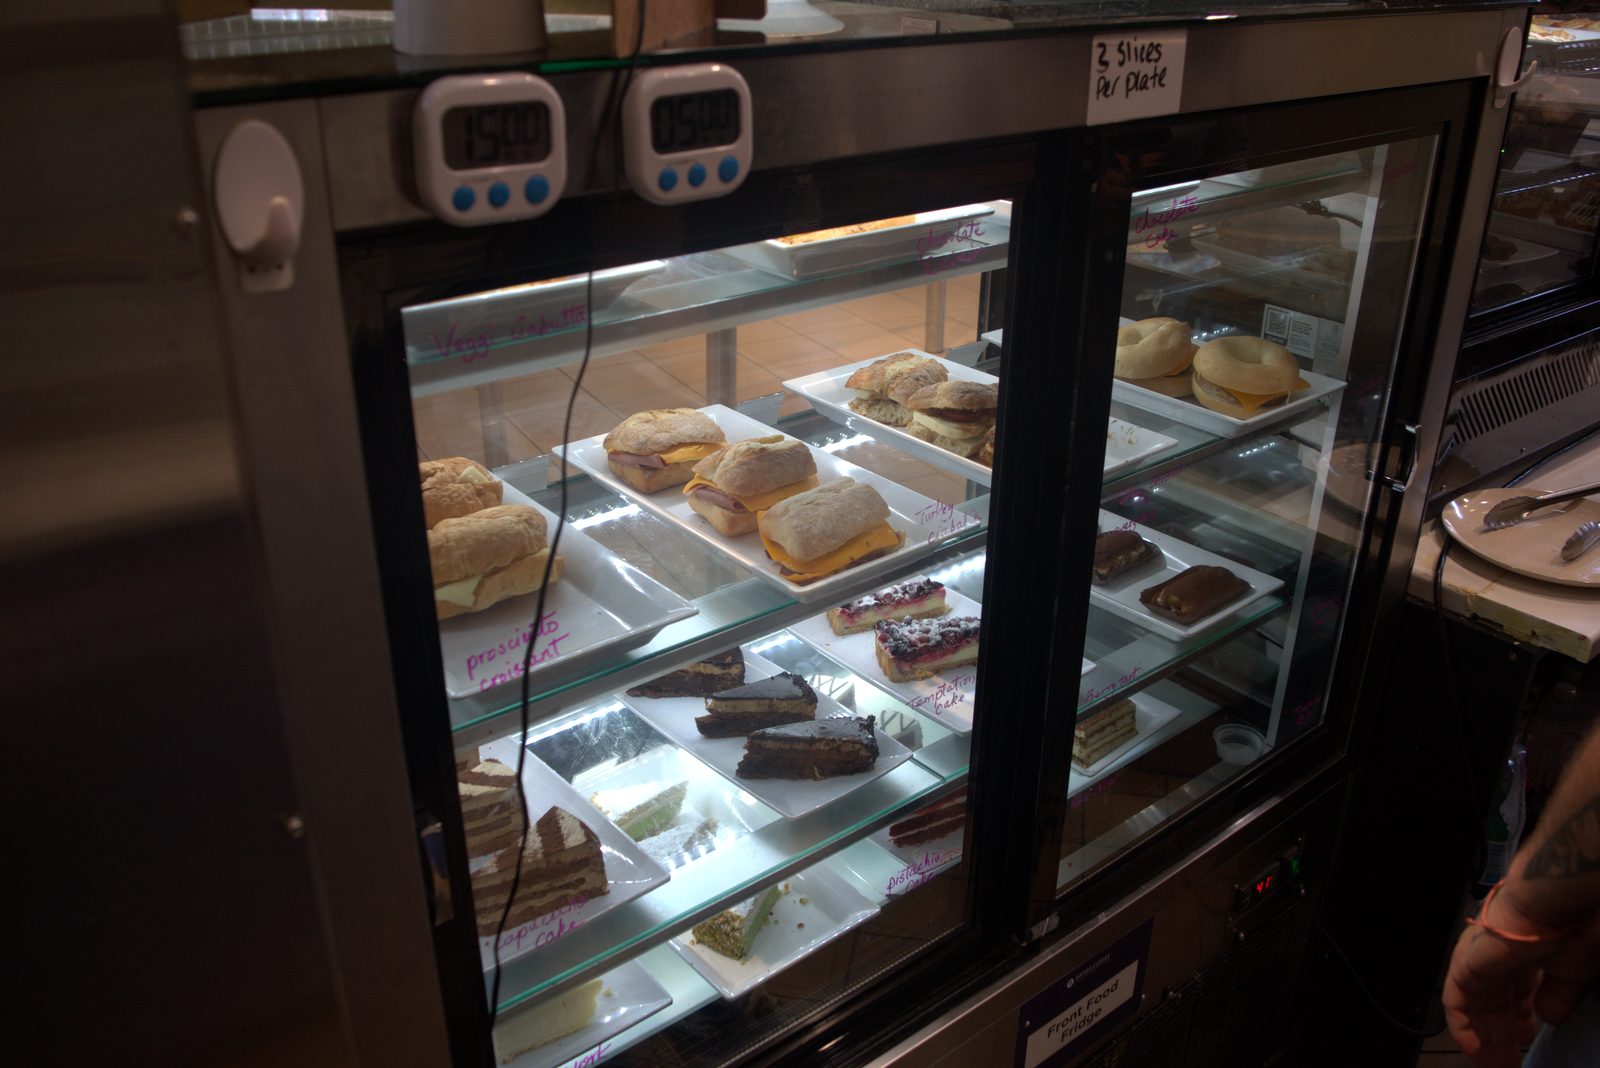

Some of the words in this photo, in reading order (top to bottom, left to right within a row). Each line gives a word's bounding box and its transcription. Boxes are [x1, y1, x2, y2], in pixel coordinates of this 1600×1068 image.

[1047, 1006, 1083, 1038] Front
[1086, 979, 1119, 1010] Food
[1061, 1007, 1102, 1042] Fridge
